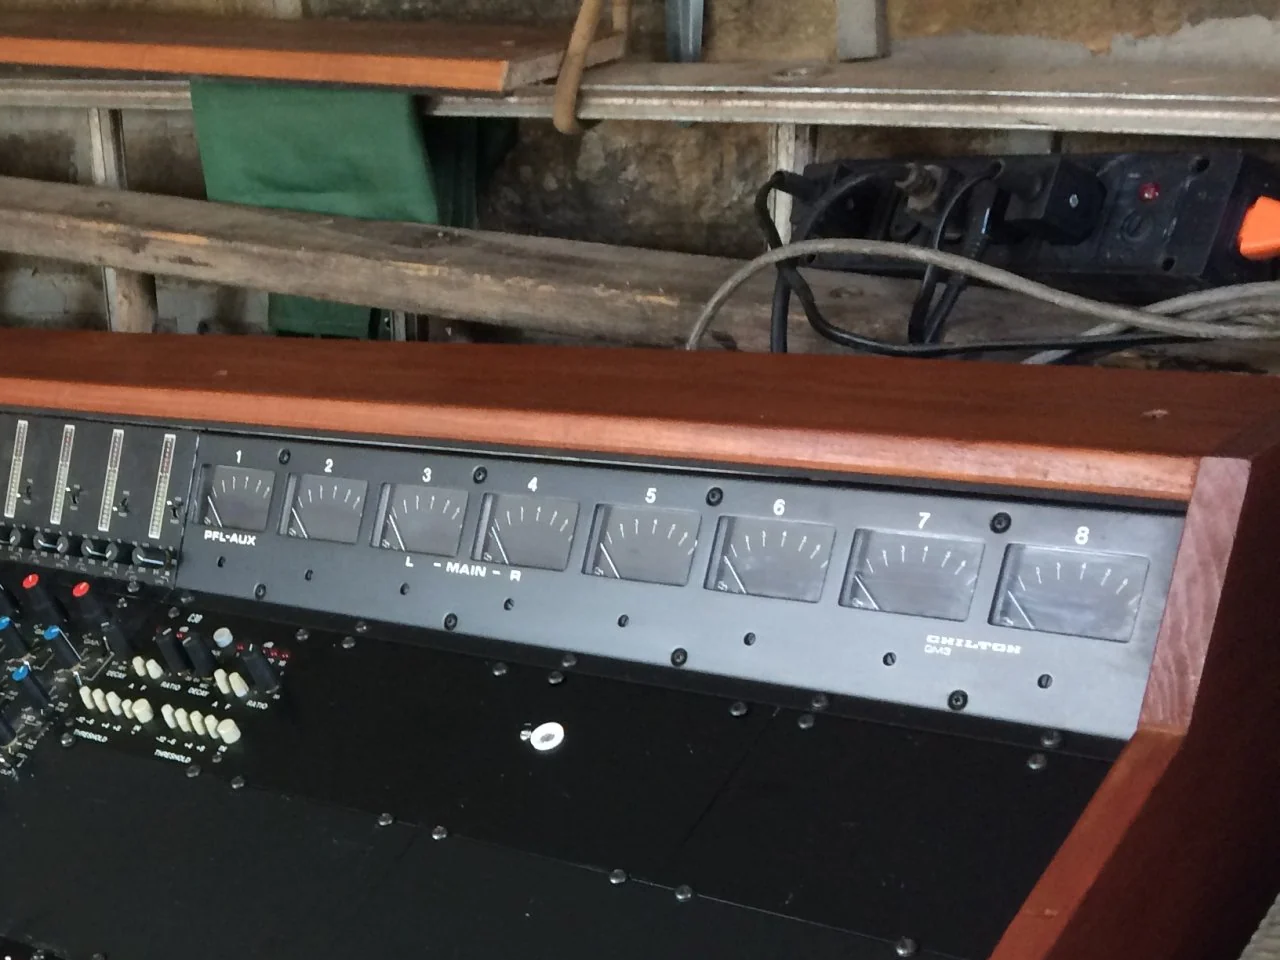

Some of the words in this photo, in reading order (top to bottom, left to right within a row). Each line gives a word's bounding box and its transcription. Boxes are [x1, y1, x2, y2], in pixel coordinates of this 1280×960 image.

[235, 450, 242, 464] 1
[324, 458, 334, 473] 2
[422, 467, 432, 483] 3
[527, 476, 538, 492] 4
[645, 487, 657, 503] 5
[773, 498, 786, 516] 6
[918, 511, 931, 529] 7
[1074, 526, 1090, 545] 8
[404, 555, 414, 568] L
[446, 561, 487, 578] MAIN
[509, 569, 522, 582] R
[926, 634, 1021, 654] CHILTON
[246, 699, 269, 711] RATIO
[73, 728, 109, 743] THRESHOLD
[154, 748, 192, 764] THRESHOLD
